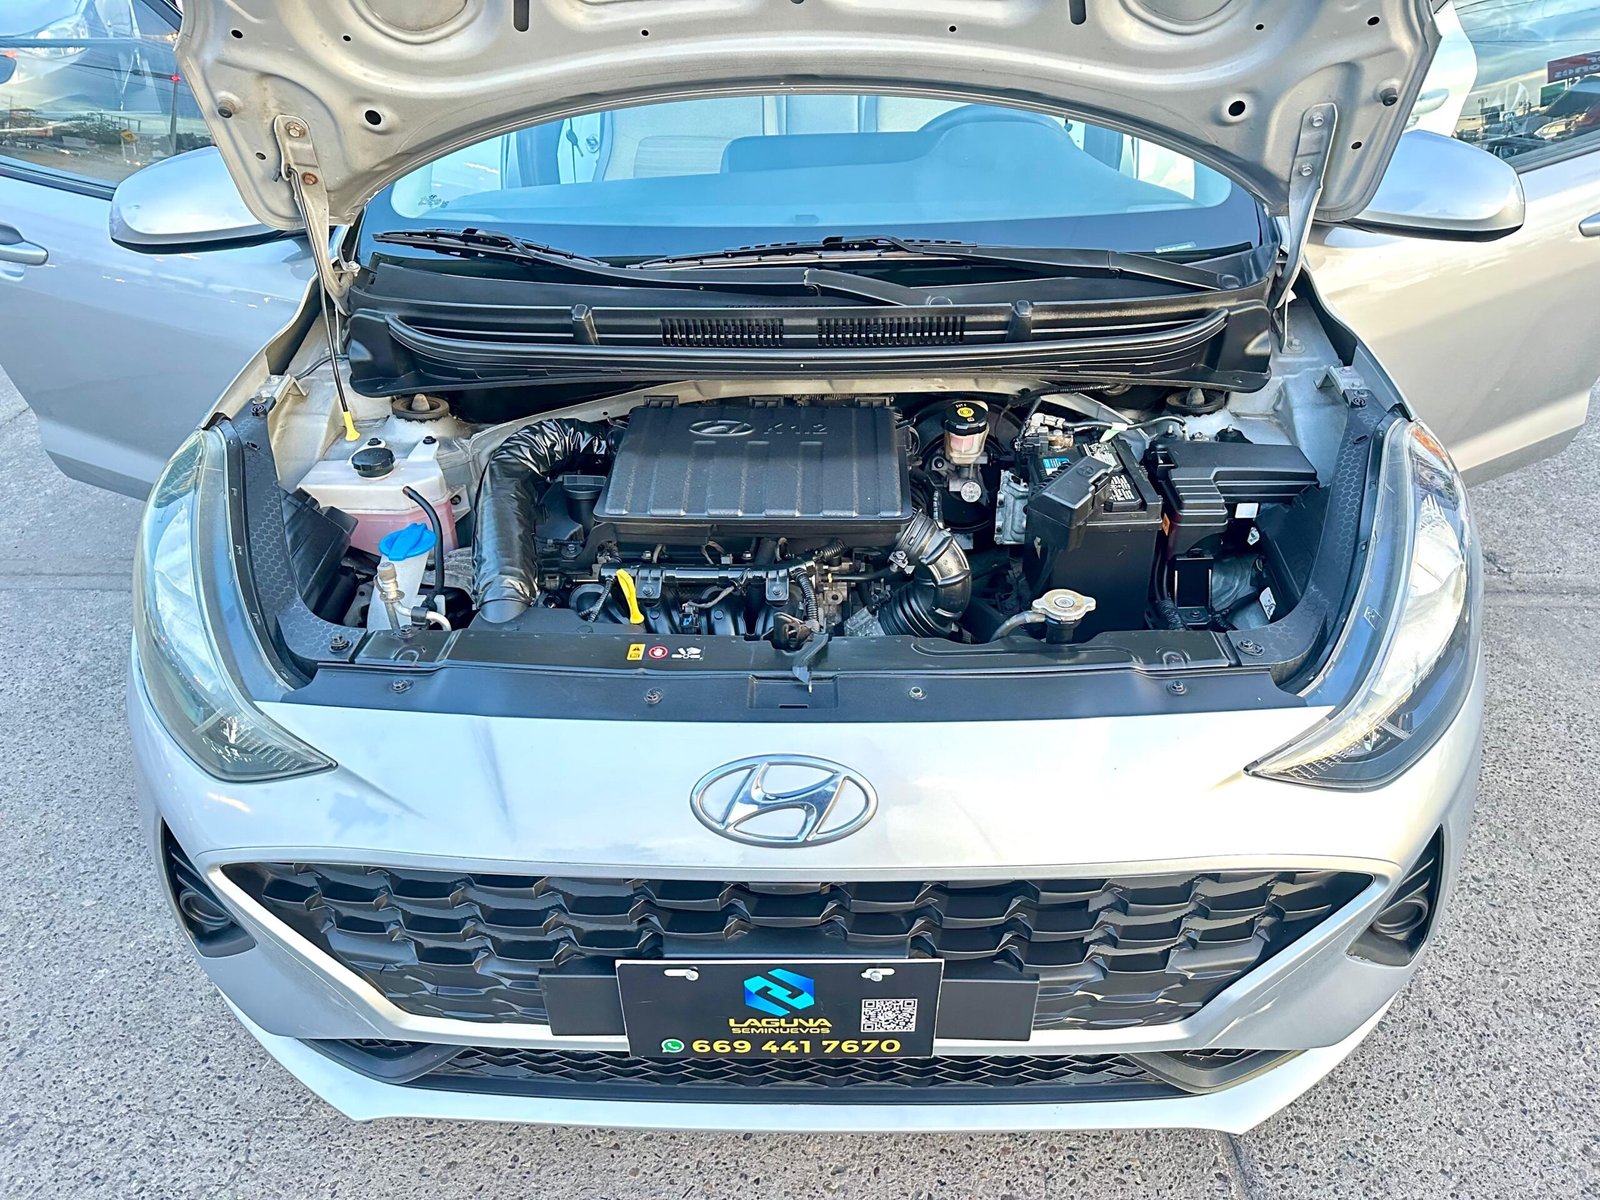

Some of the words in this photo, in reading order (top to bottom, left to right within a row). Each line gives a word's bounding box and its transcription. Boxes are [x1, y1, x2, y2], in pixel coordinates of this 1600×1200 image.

[728, 1018, 833, 1028] LAGUNA
[692, 1040, 752, 1053] 669
[761, 1040, 811, 1053] 441
[821, 1039, 901, 1053] 7670
